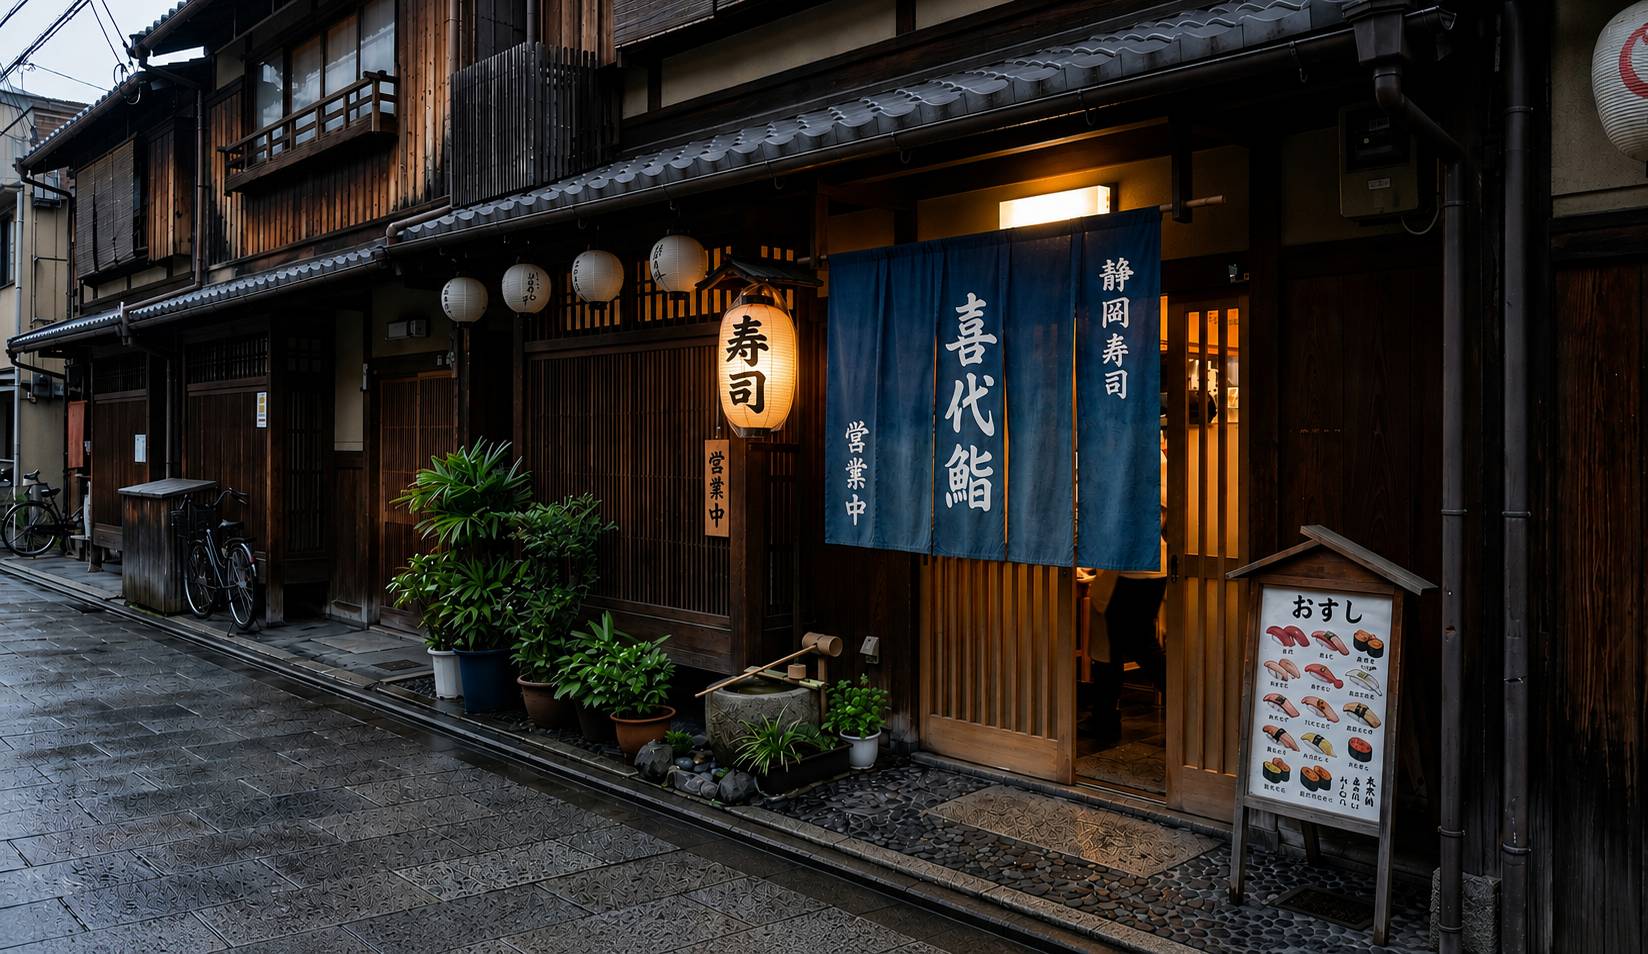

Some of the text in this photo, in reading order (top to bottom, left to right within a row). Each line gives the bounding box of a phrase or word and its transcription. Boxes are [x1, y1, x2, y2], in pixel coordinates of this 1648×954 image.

[726, 314, 769, 414] 寿司
[945, 292, 997, 512] 喜代鮨
[708, 451, 725, 529] 営業中
[845, 420, 870, 526] 営業中
[1292, 594, 1363, 624] おすし
